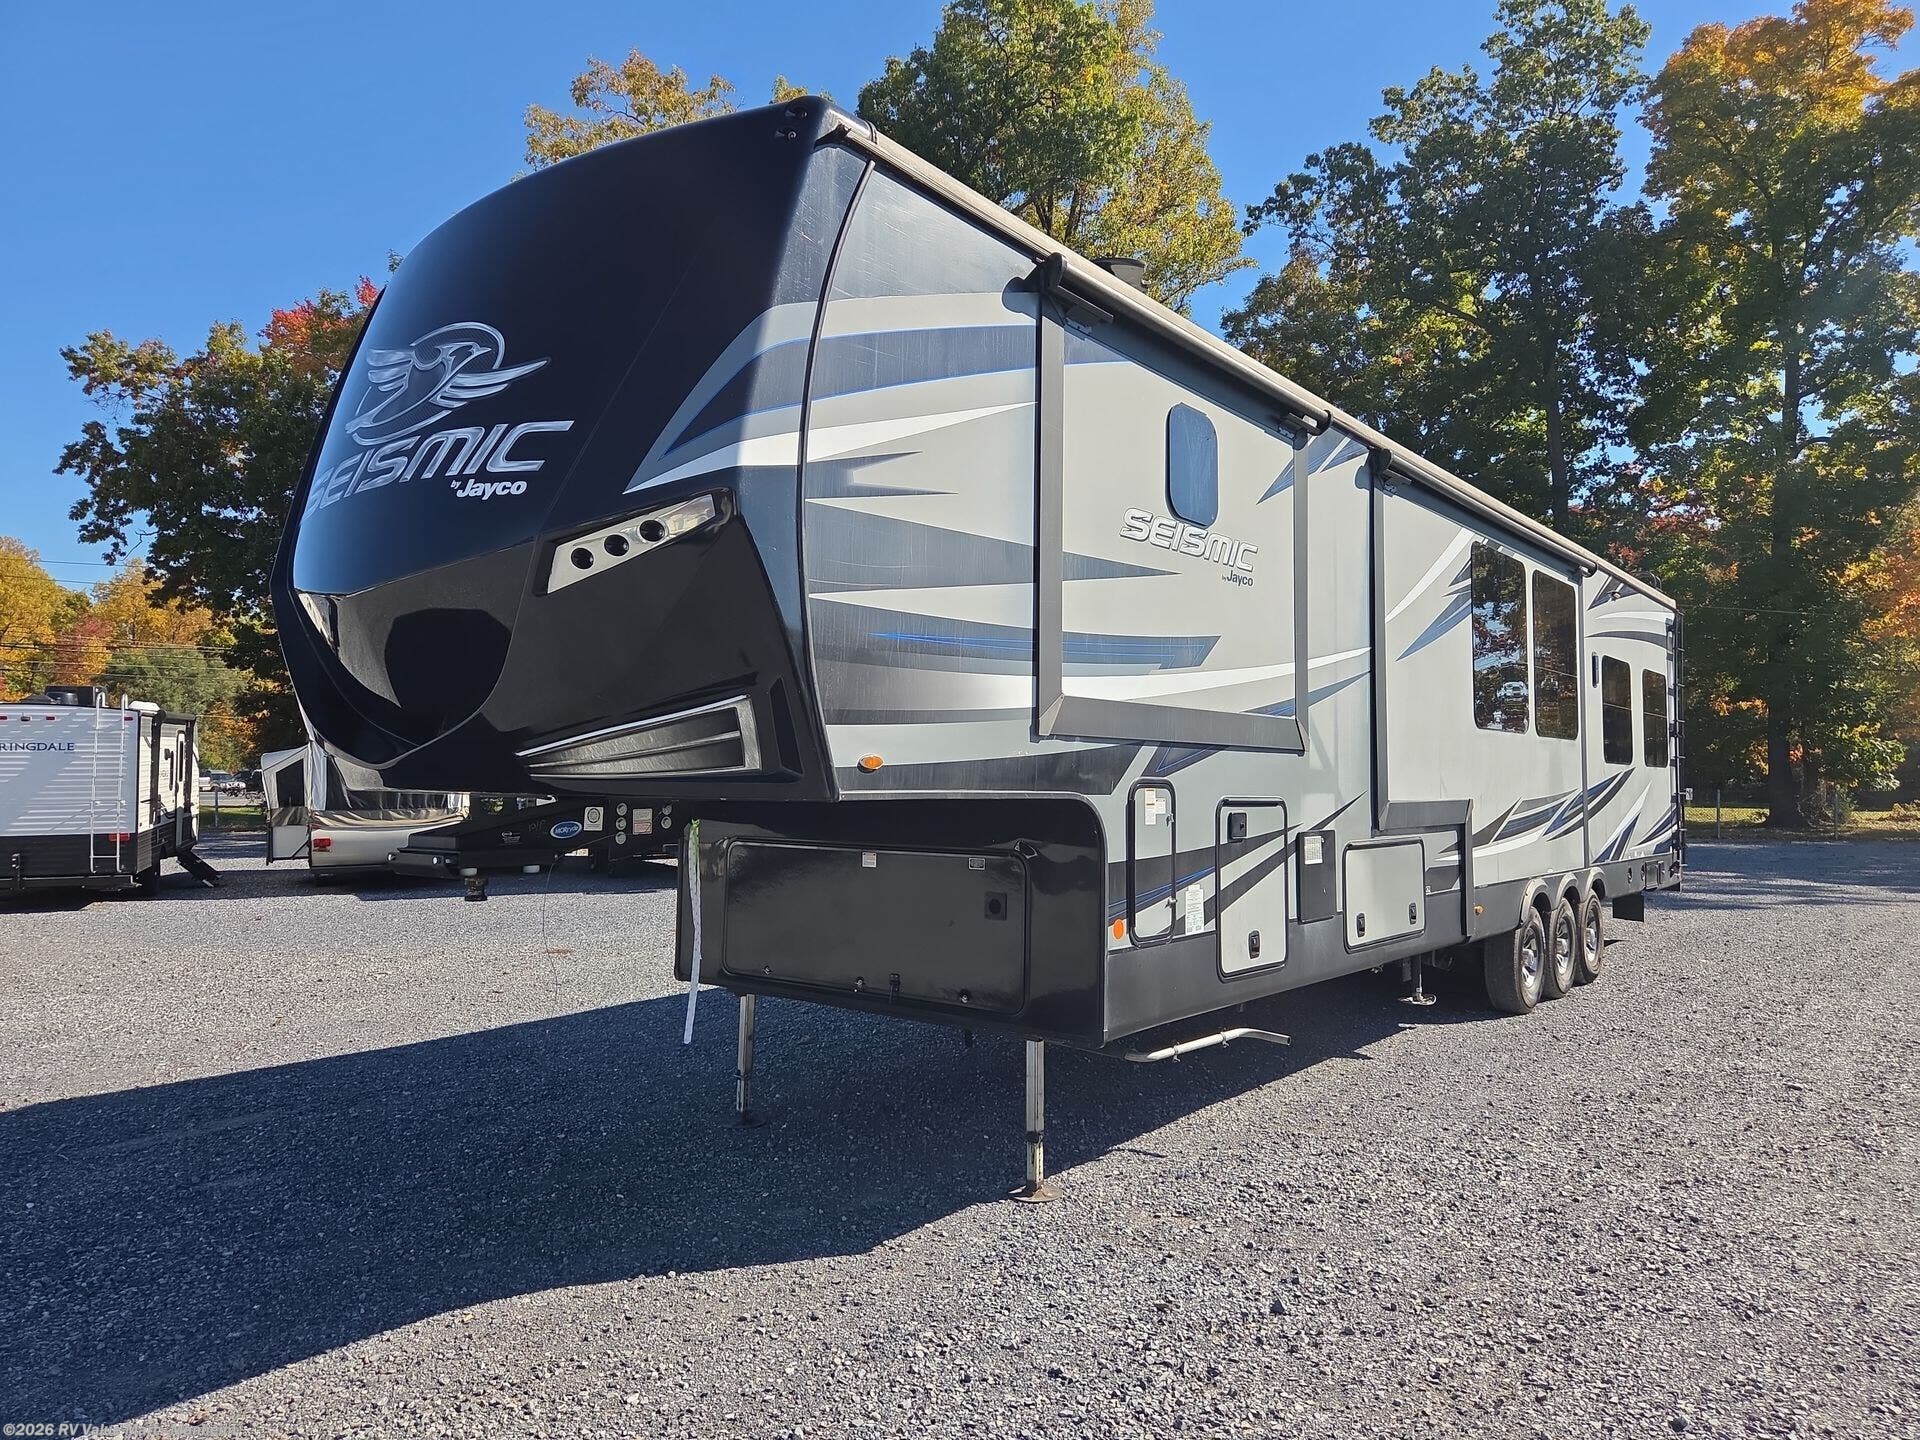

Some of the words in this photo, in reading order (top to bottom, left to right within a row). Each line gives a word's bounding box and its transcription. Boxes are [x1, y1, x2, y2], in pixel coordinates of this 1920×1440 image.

[300, 420, 575, 523] SEISMIC
[450, 479, 461, 489] by
[456, 479, 527, 500] Jayco
[1120, 508, 1258, 572] SEISMIC
[1226, 569, 1254, 587] Jayco
